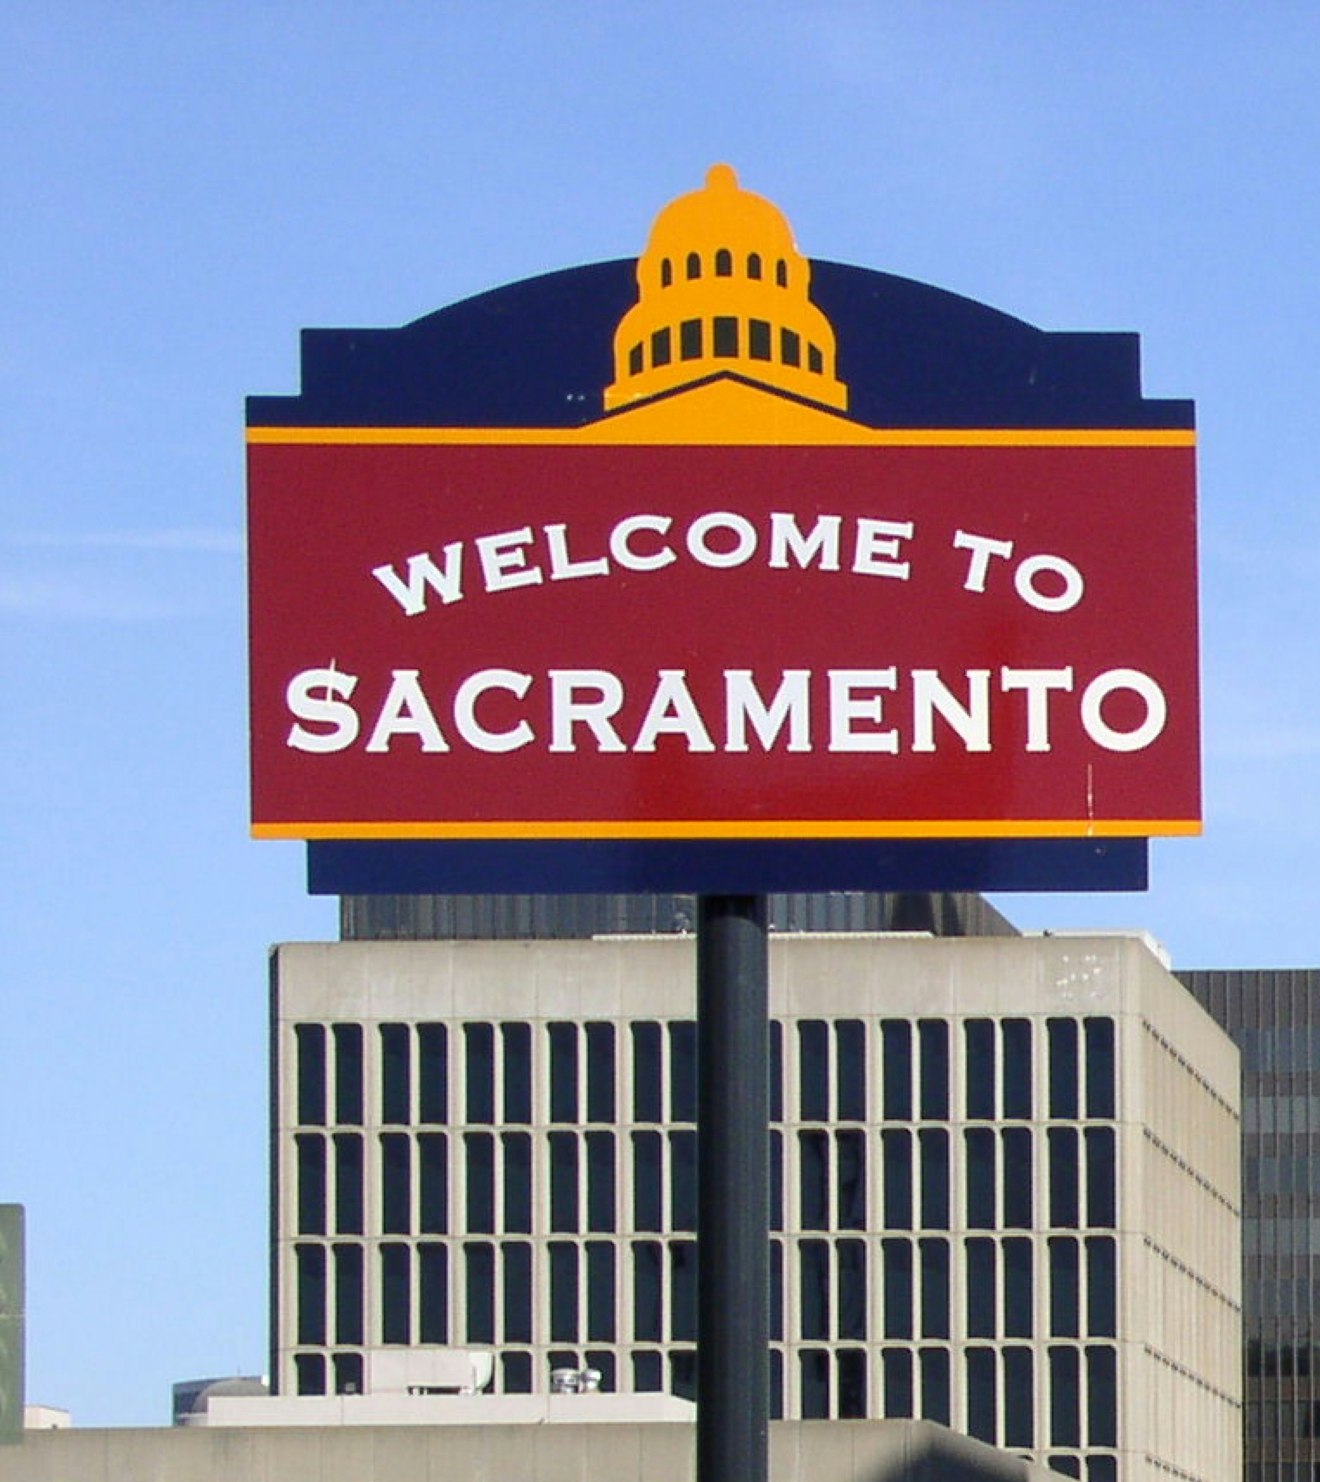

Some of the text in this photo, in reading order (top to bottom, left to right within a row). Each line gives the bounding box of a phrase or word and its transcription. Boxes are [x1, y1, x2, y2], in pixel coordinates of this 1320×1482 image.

[372, 511, 1085, 616] WELCOME TO
[285, 666, 1167, 755] SACRAMENTO
